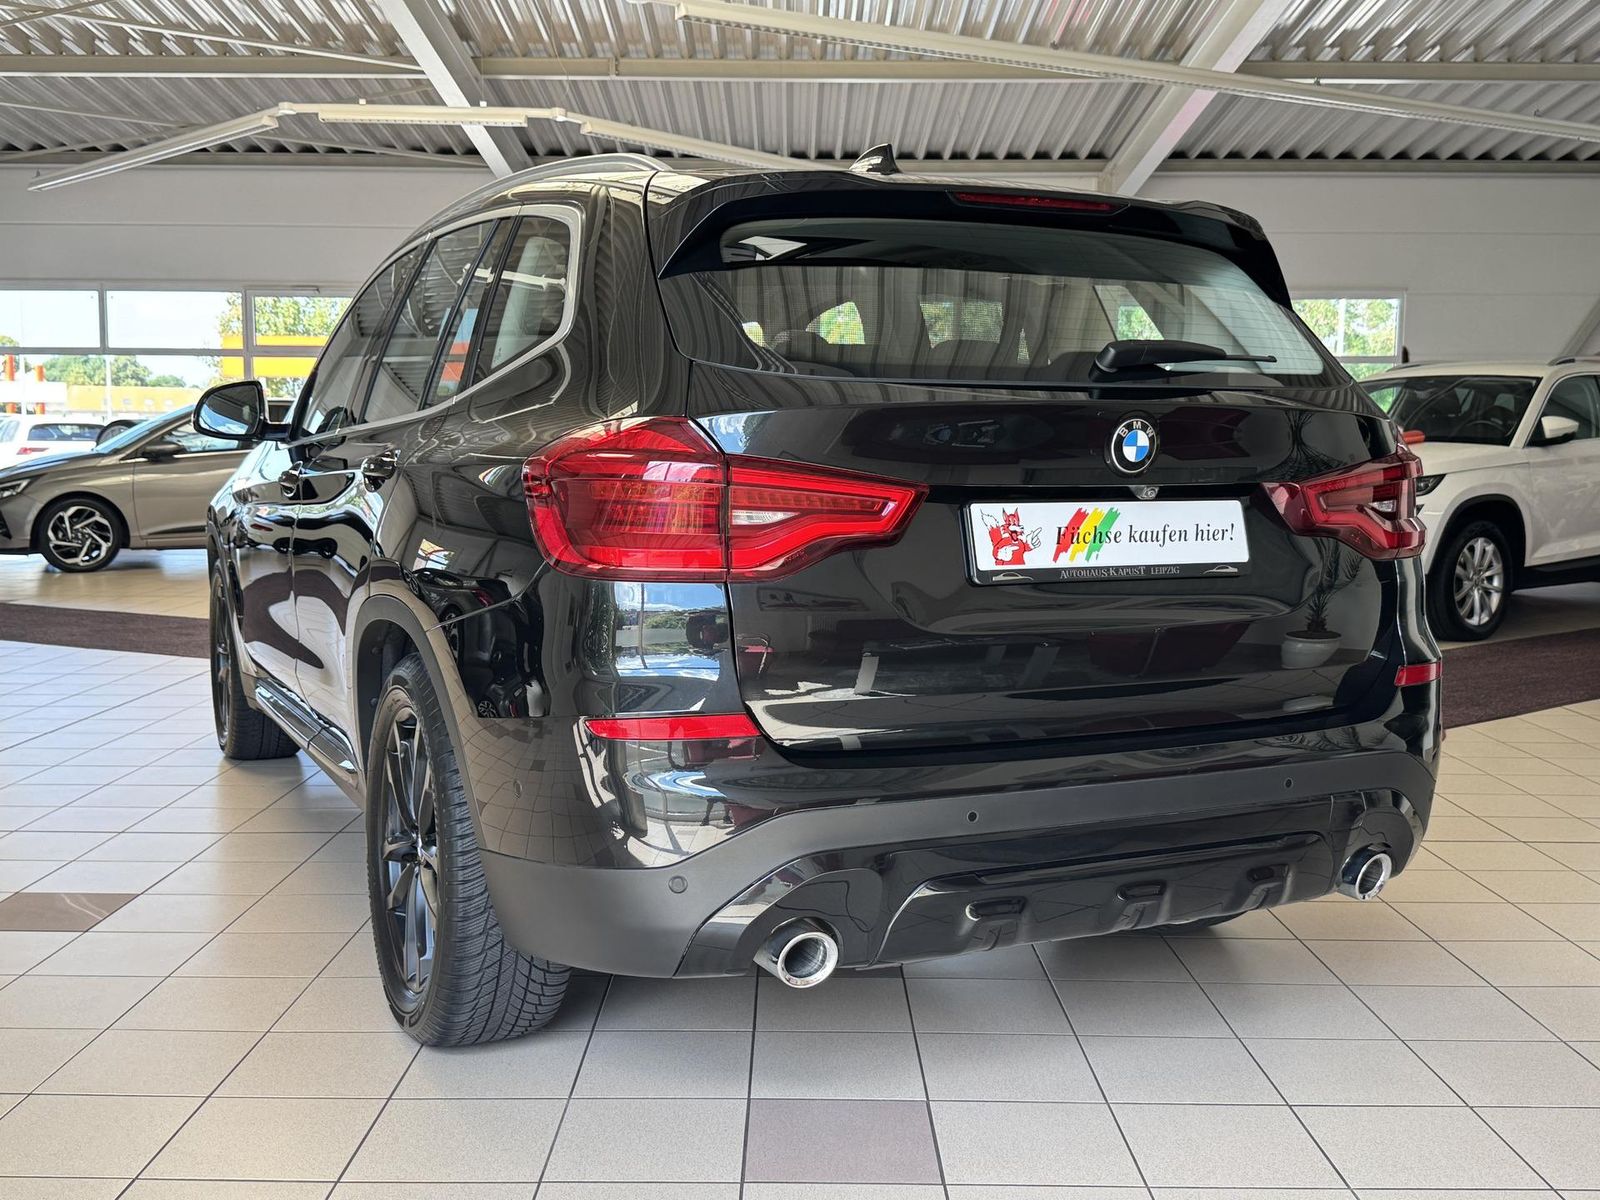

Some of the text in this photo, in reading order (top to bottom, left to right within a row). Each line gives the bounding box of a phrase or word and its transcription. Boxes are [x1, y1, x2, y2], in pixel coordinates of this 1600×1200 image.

[1118, 421, 1154, 437] BMW
[1056, 523, 1235, 548] Füchse kaufen hier!
[1150, 566, 1180, 575] LEIPZIG
